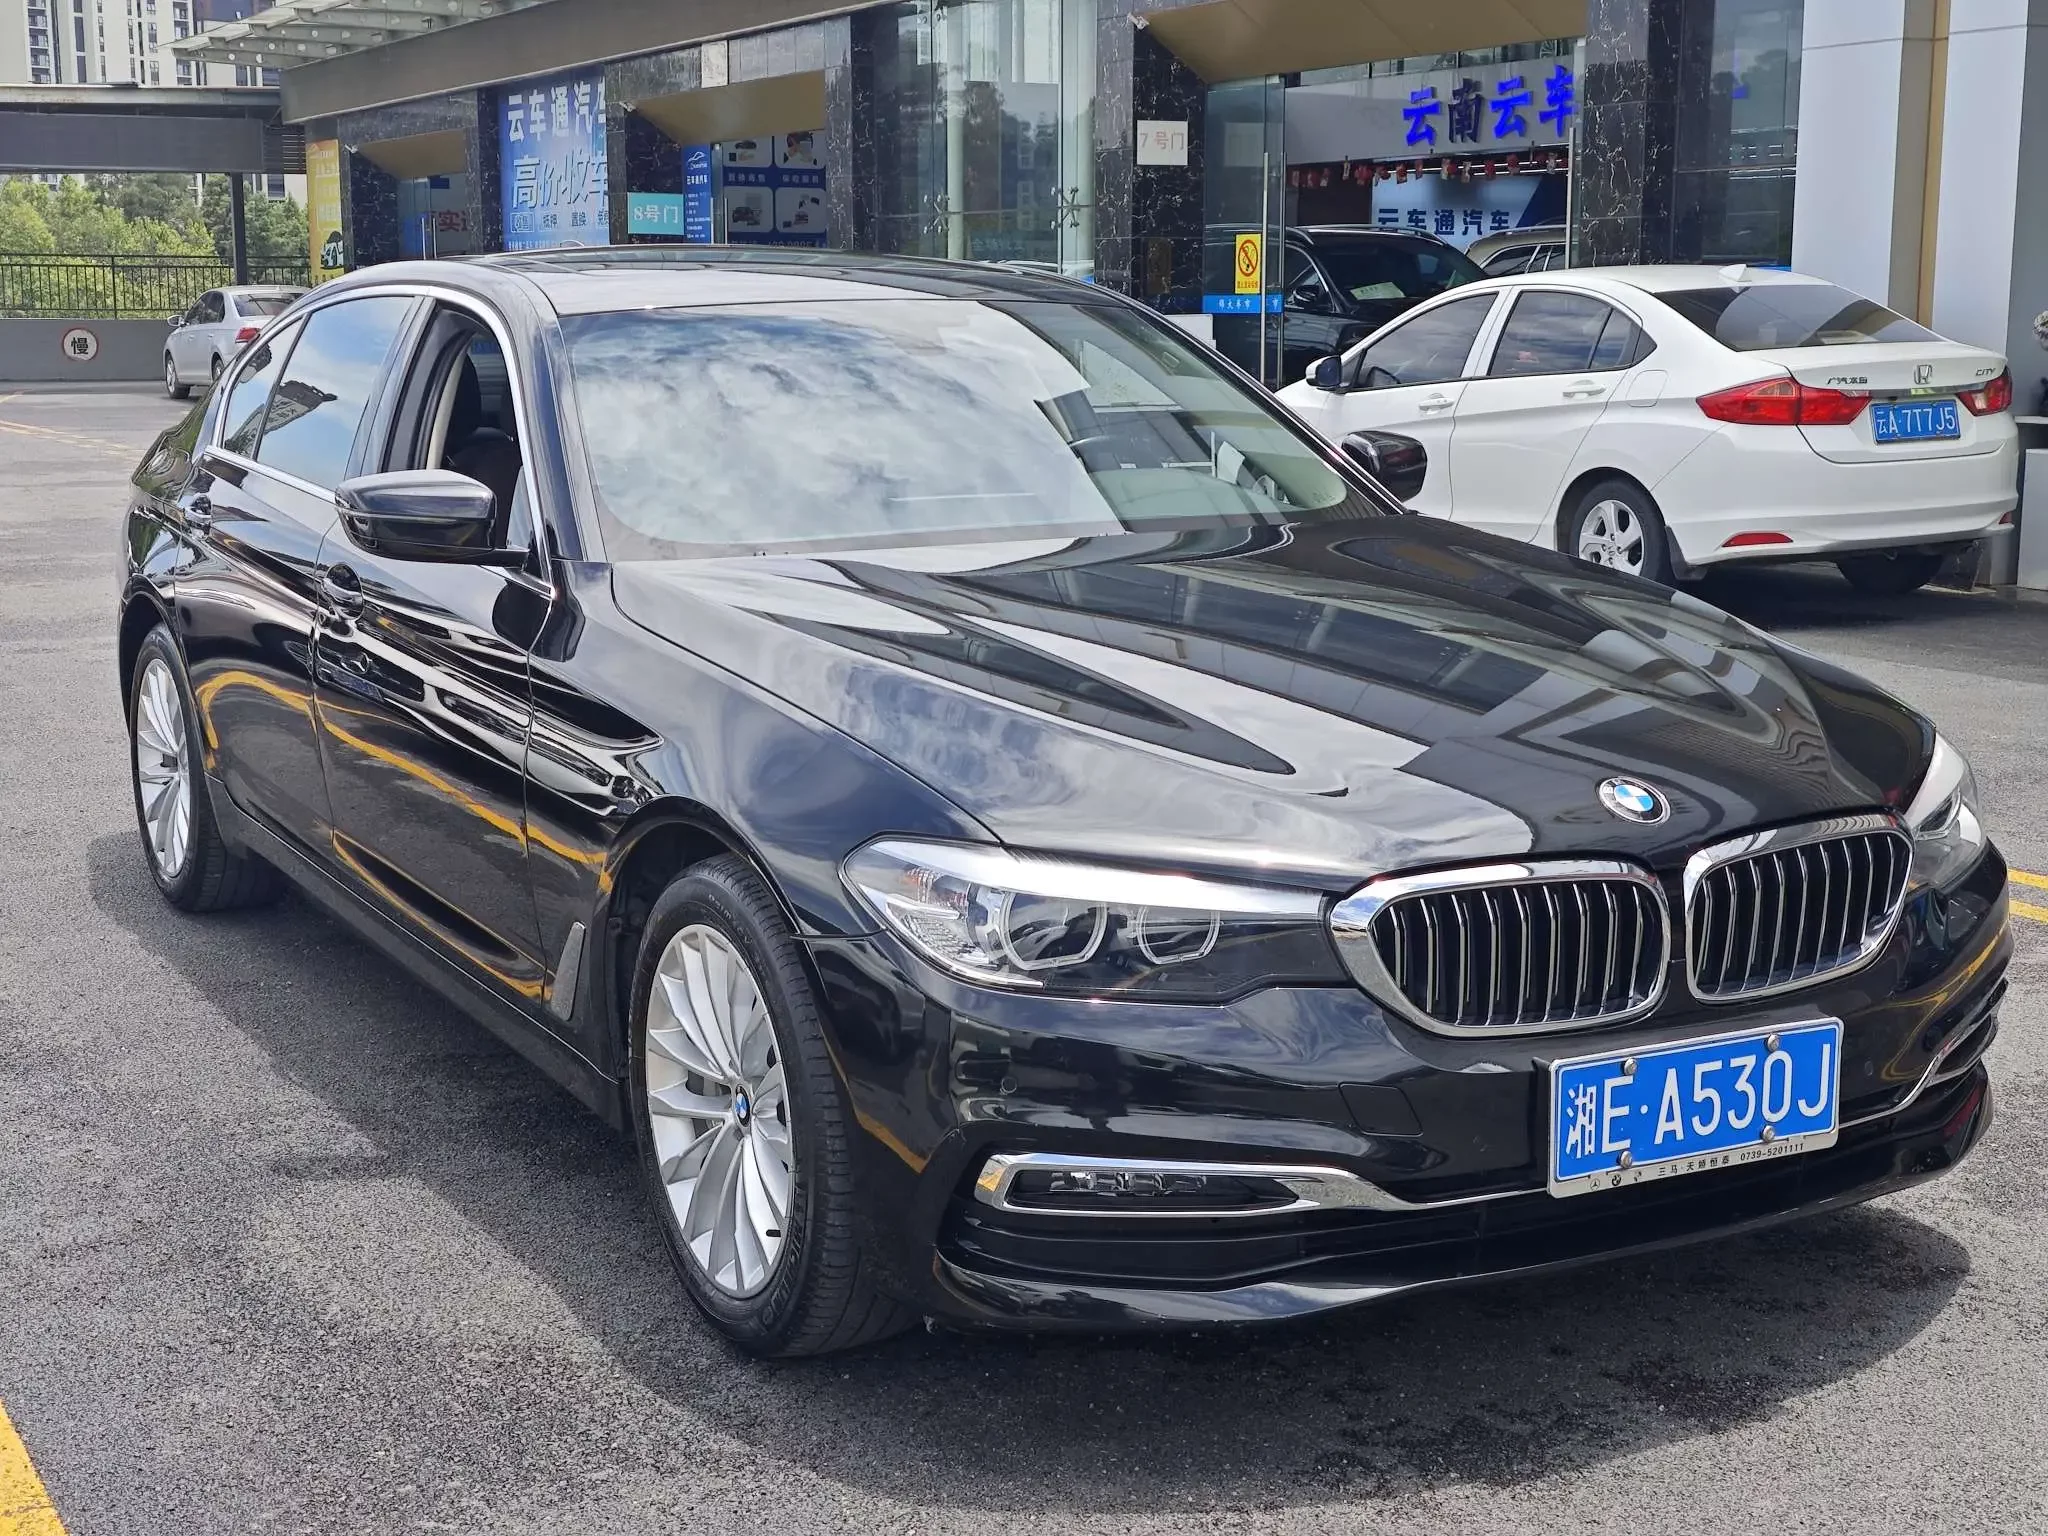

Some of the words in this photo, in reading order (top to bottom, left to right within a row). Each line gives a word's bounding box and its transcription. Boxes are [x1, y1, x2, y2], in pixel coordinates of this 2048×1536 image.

[1403, 64, 1574, 147] 云南云车
[1139, 131, 1185, 150] 7号门
[633, 204, 679, 225] 8号门
[70, 336, 89, 355] 慢
[1974, 367, 1997, 377] CITY
[1565, 1043, 1831, 1159] 湘E·A530J
